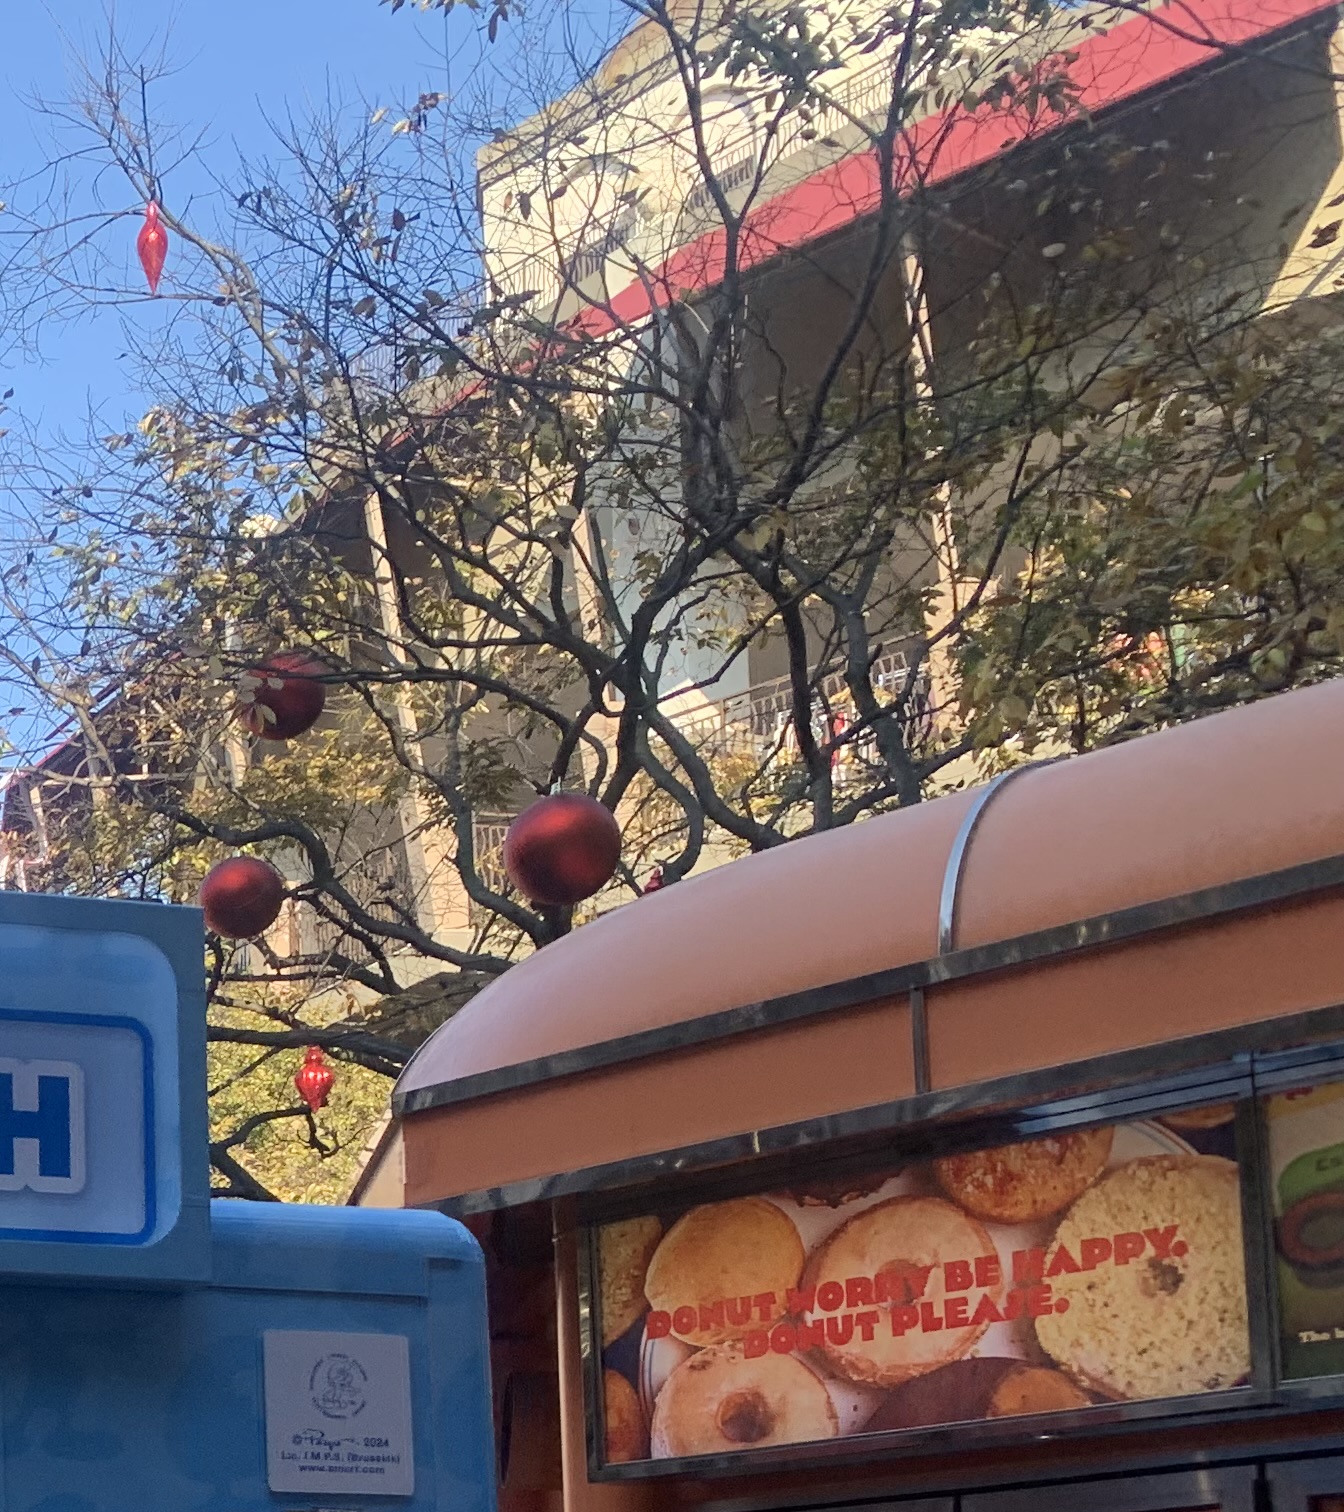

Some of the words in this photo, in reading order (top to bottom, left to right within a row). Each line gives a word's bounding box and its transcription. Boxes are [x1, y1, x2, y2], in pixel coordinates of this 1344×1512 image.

[646, 1291, 777, 1339] DONUT
[786, 1265, 935, 1316] WORRY
[944, 1254, 1000, 1293] BE
[1012, 1225, 1190, 1283] HAPPY.
[744, 1311, 880, 1359] DONUT
[891, 1283, 1070, 1337] PLEASE.
